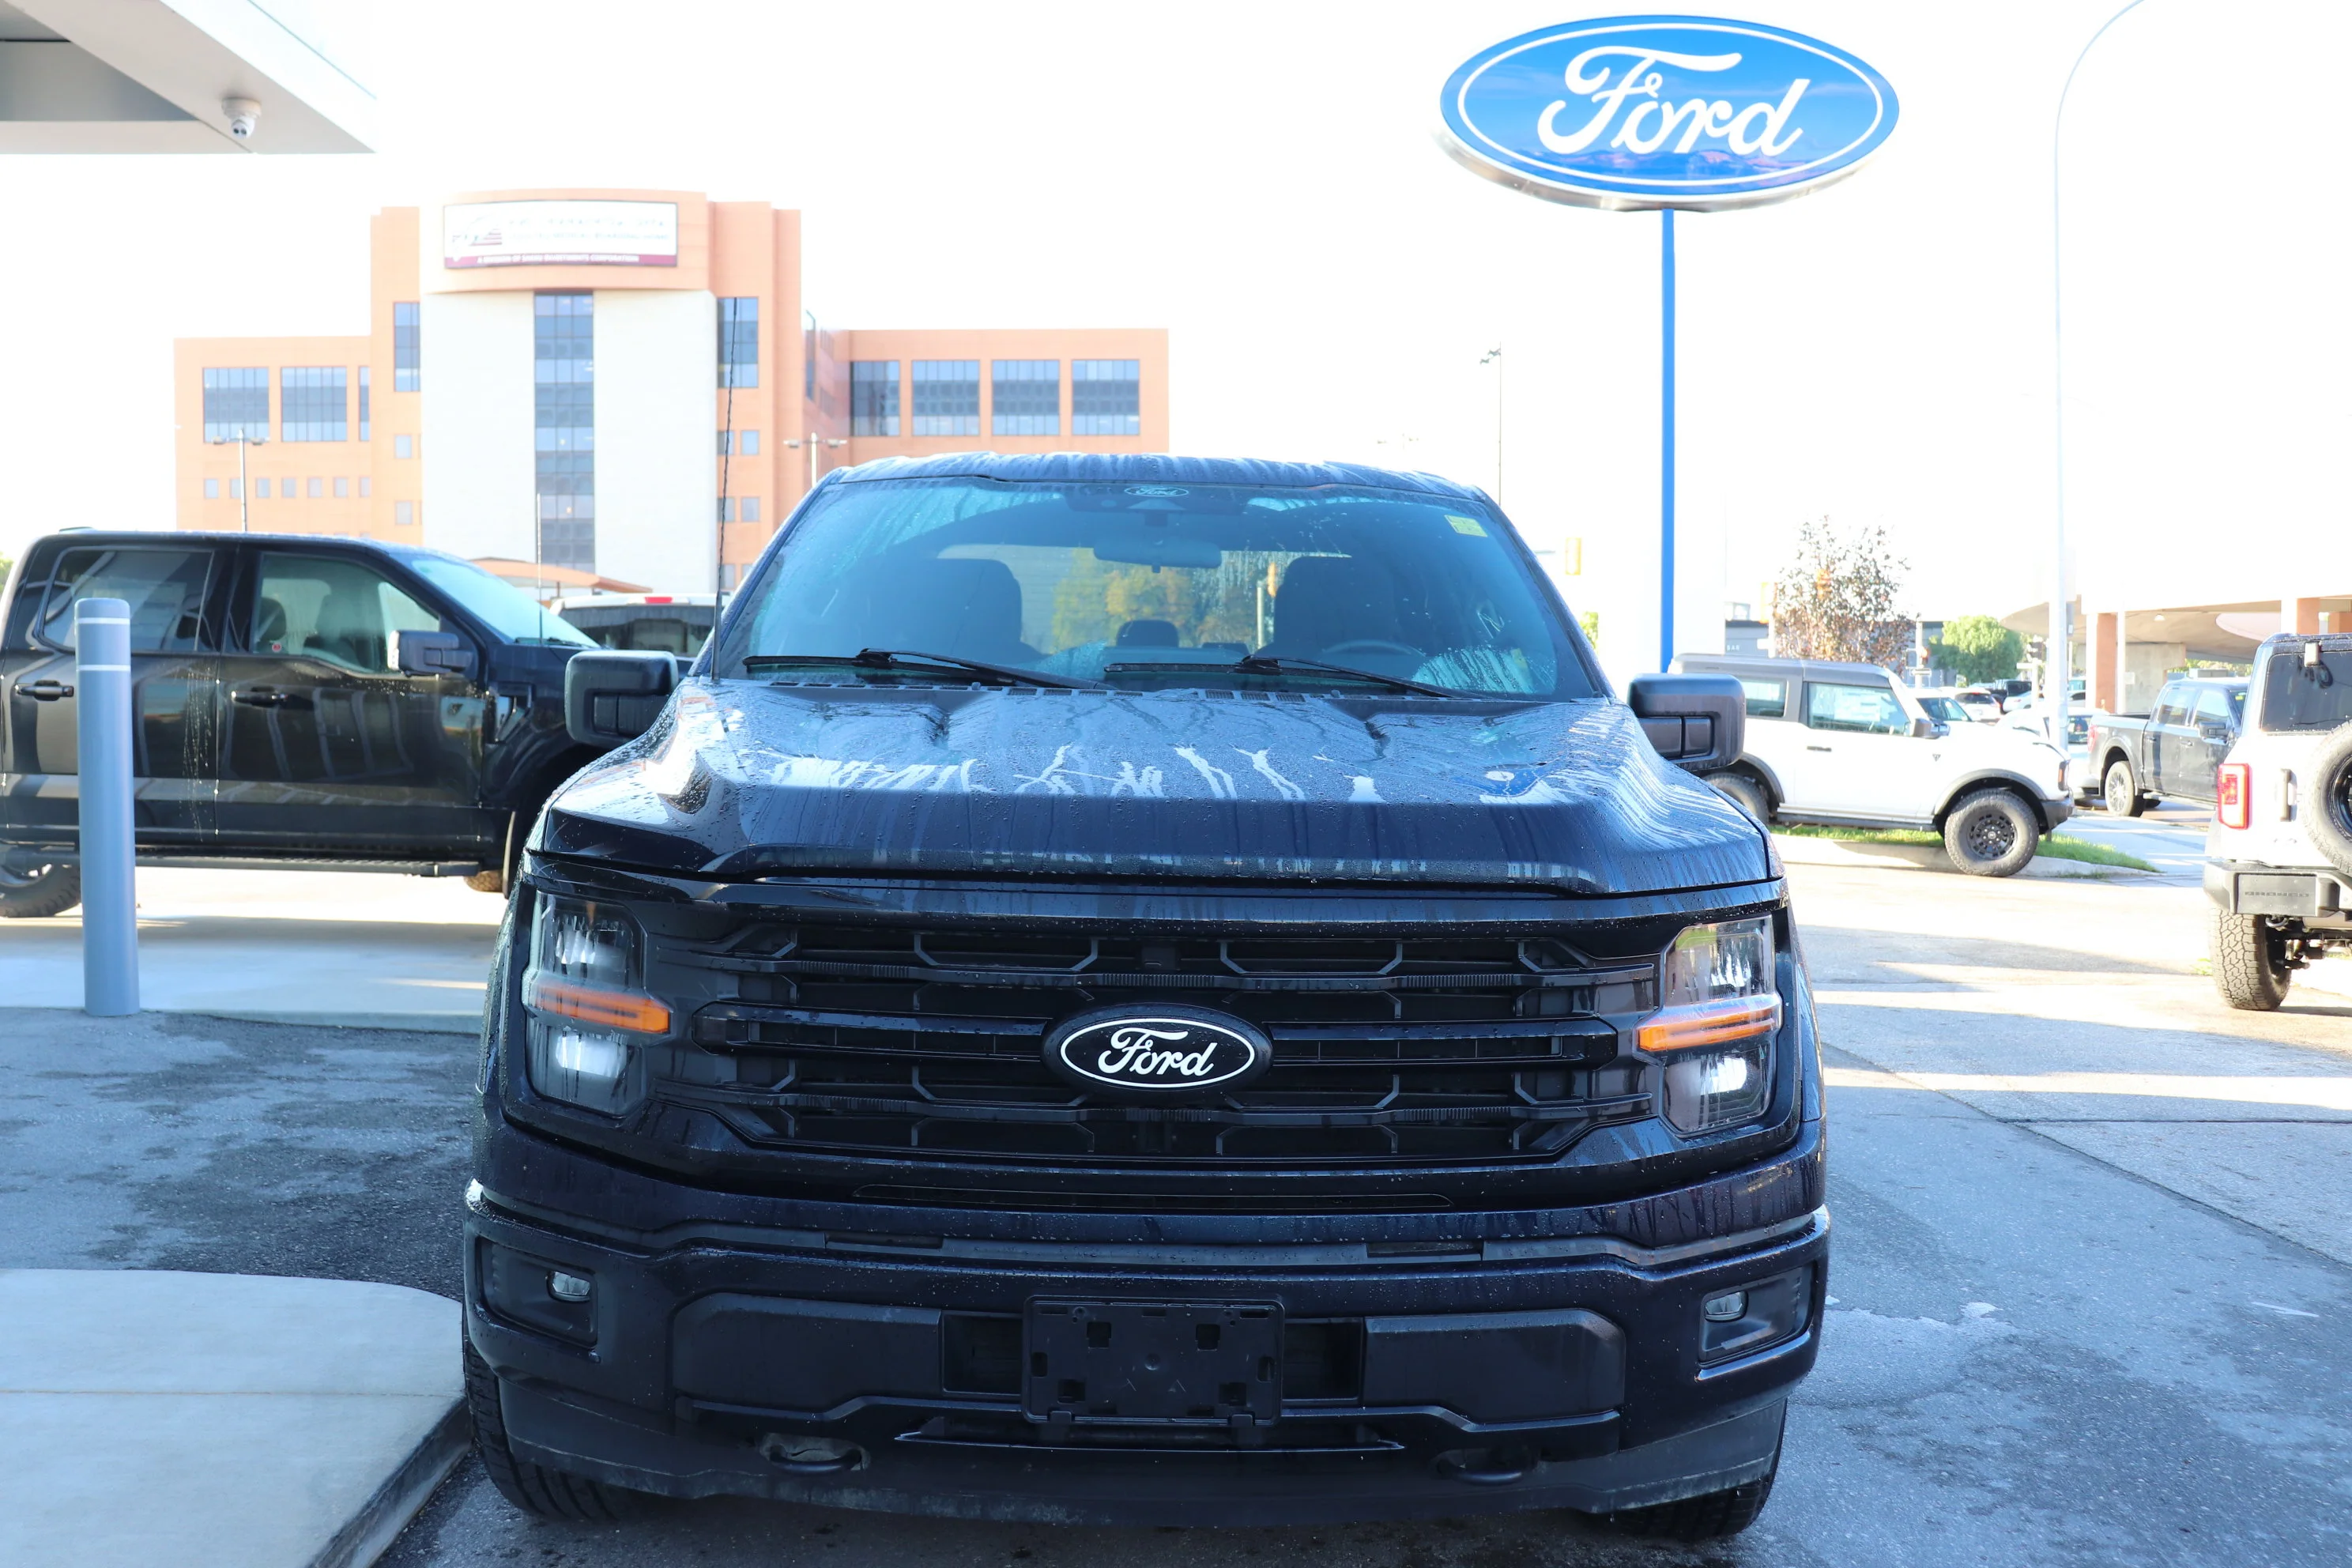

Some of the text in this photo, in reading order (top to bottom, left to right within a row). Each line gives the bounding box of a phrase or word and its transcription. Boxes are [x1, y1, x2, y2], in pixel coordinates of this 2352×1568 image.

[1537, 46, 1811, 156] Ford
[1136, 486, 1178, 495] Ford
[1098, 1027, 1218, 1076] Ford
